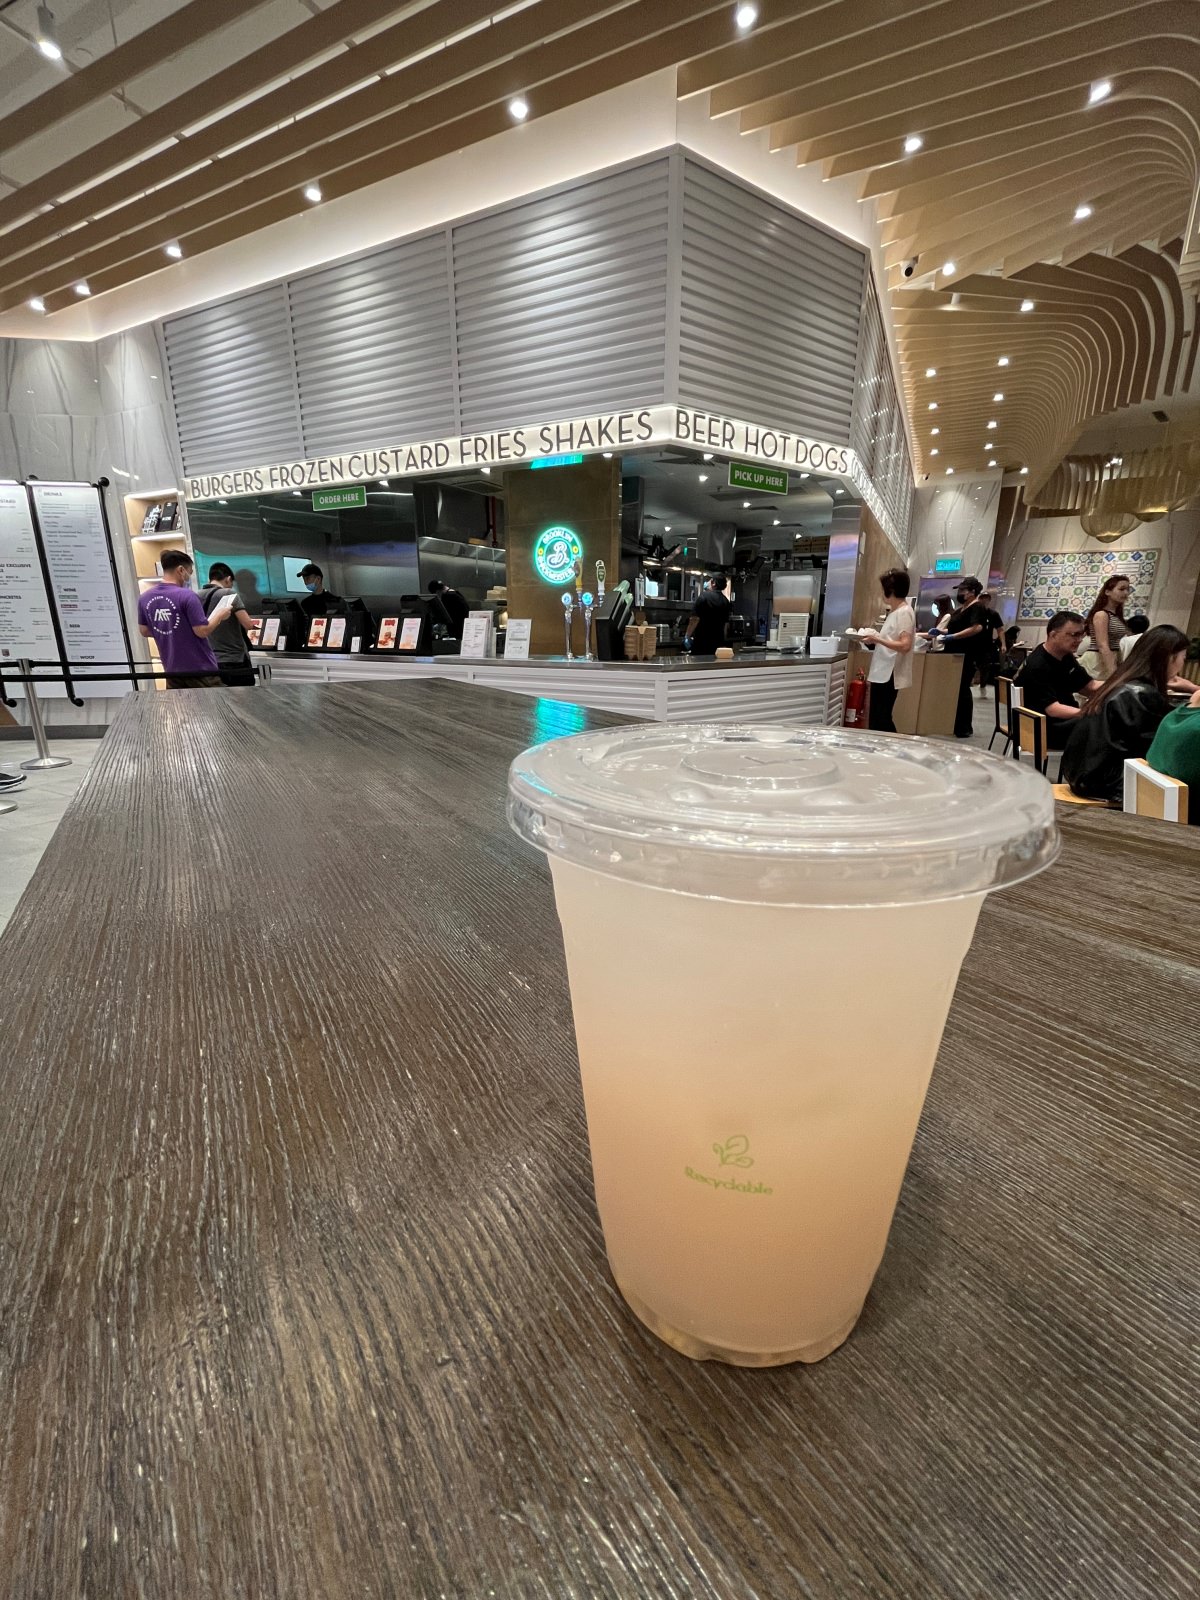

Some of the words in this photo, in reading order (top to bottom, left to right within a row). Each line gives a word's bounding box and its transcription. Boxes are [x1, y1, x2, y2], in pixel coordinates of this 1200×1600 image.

[191, 470, 264, 499] BURGERS
[269, 458, 344, 488] FROZEN
[348, 443, 450, 478] CUSTARD
[459, 430, 527, 464] FRIES
[539, 411, 653, 454] SHAKES
[675, 409, 735, 450] BEER
[745, 426, 791, 461] HOT
[795, 439, 848, 474] DOGS
[734, 469, 752, 482] PICK
[753, 473, 764, 483] UP
[765, 476, 784, 487] HERE
[319, 494, 341, 505] ORDER
[342, 492, 359, 502] HERE
[684, 1167, 773, 1195] Recyclable
